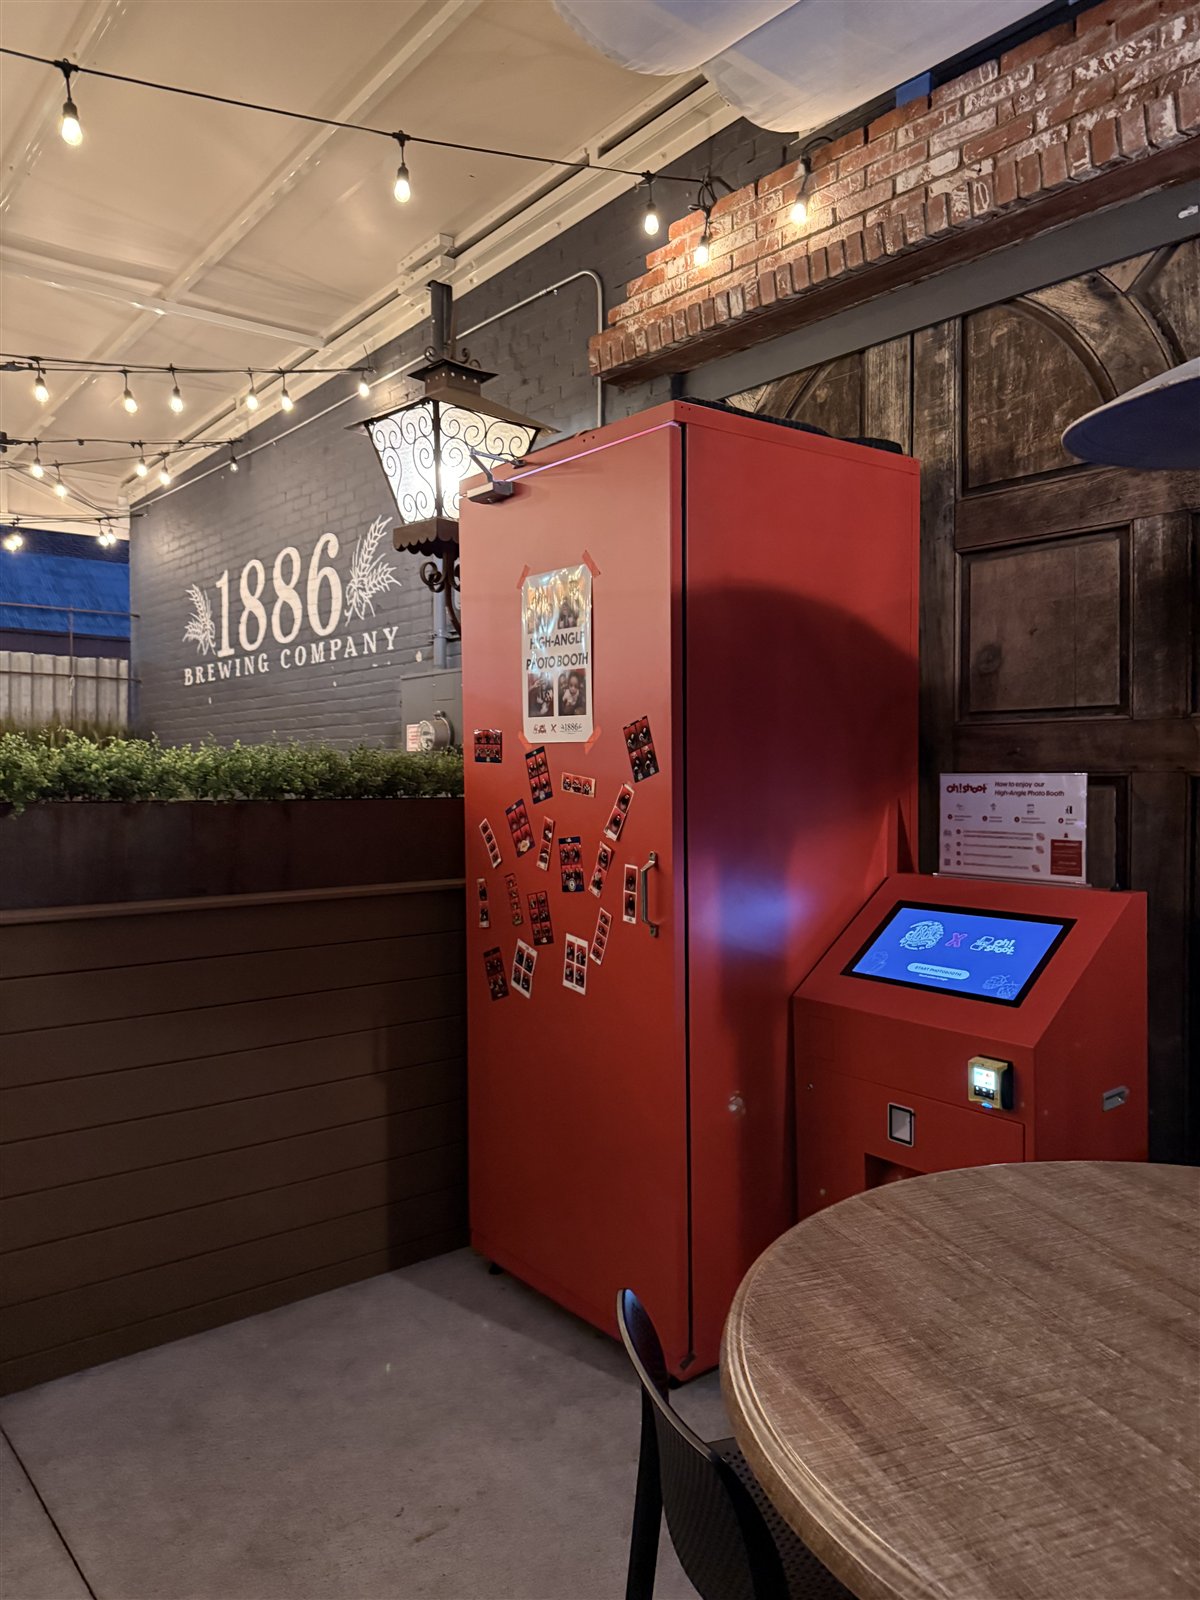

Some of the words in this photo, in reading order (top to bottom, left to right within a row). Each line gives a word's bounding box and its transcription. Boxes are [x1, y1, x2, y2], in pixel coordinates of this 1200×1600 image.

[215, 532, 343, 658] 1886
[529, 631, 585, 650] HGH-ANGLE
[183, 653, 270, 687] BREWING
[280, 626, 399, 669] COMPANY
[556, 652, 589, 667] BOOTH
[994, 790, 1027, 798] High-Angle
